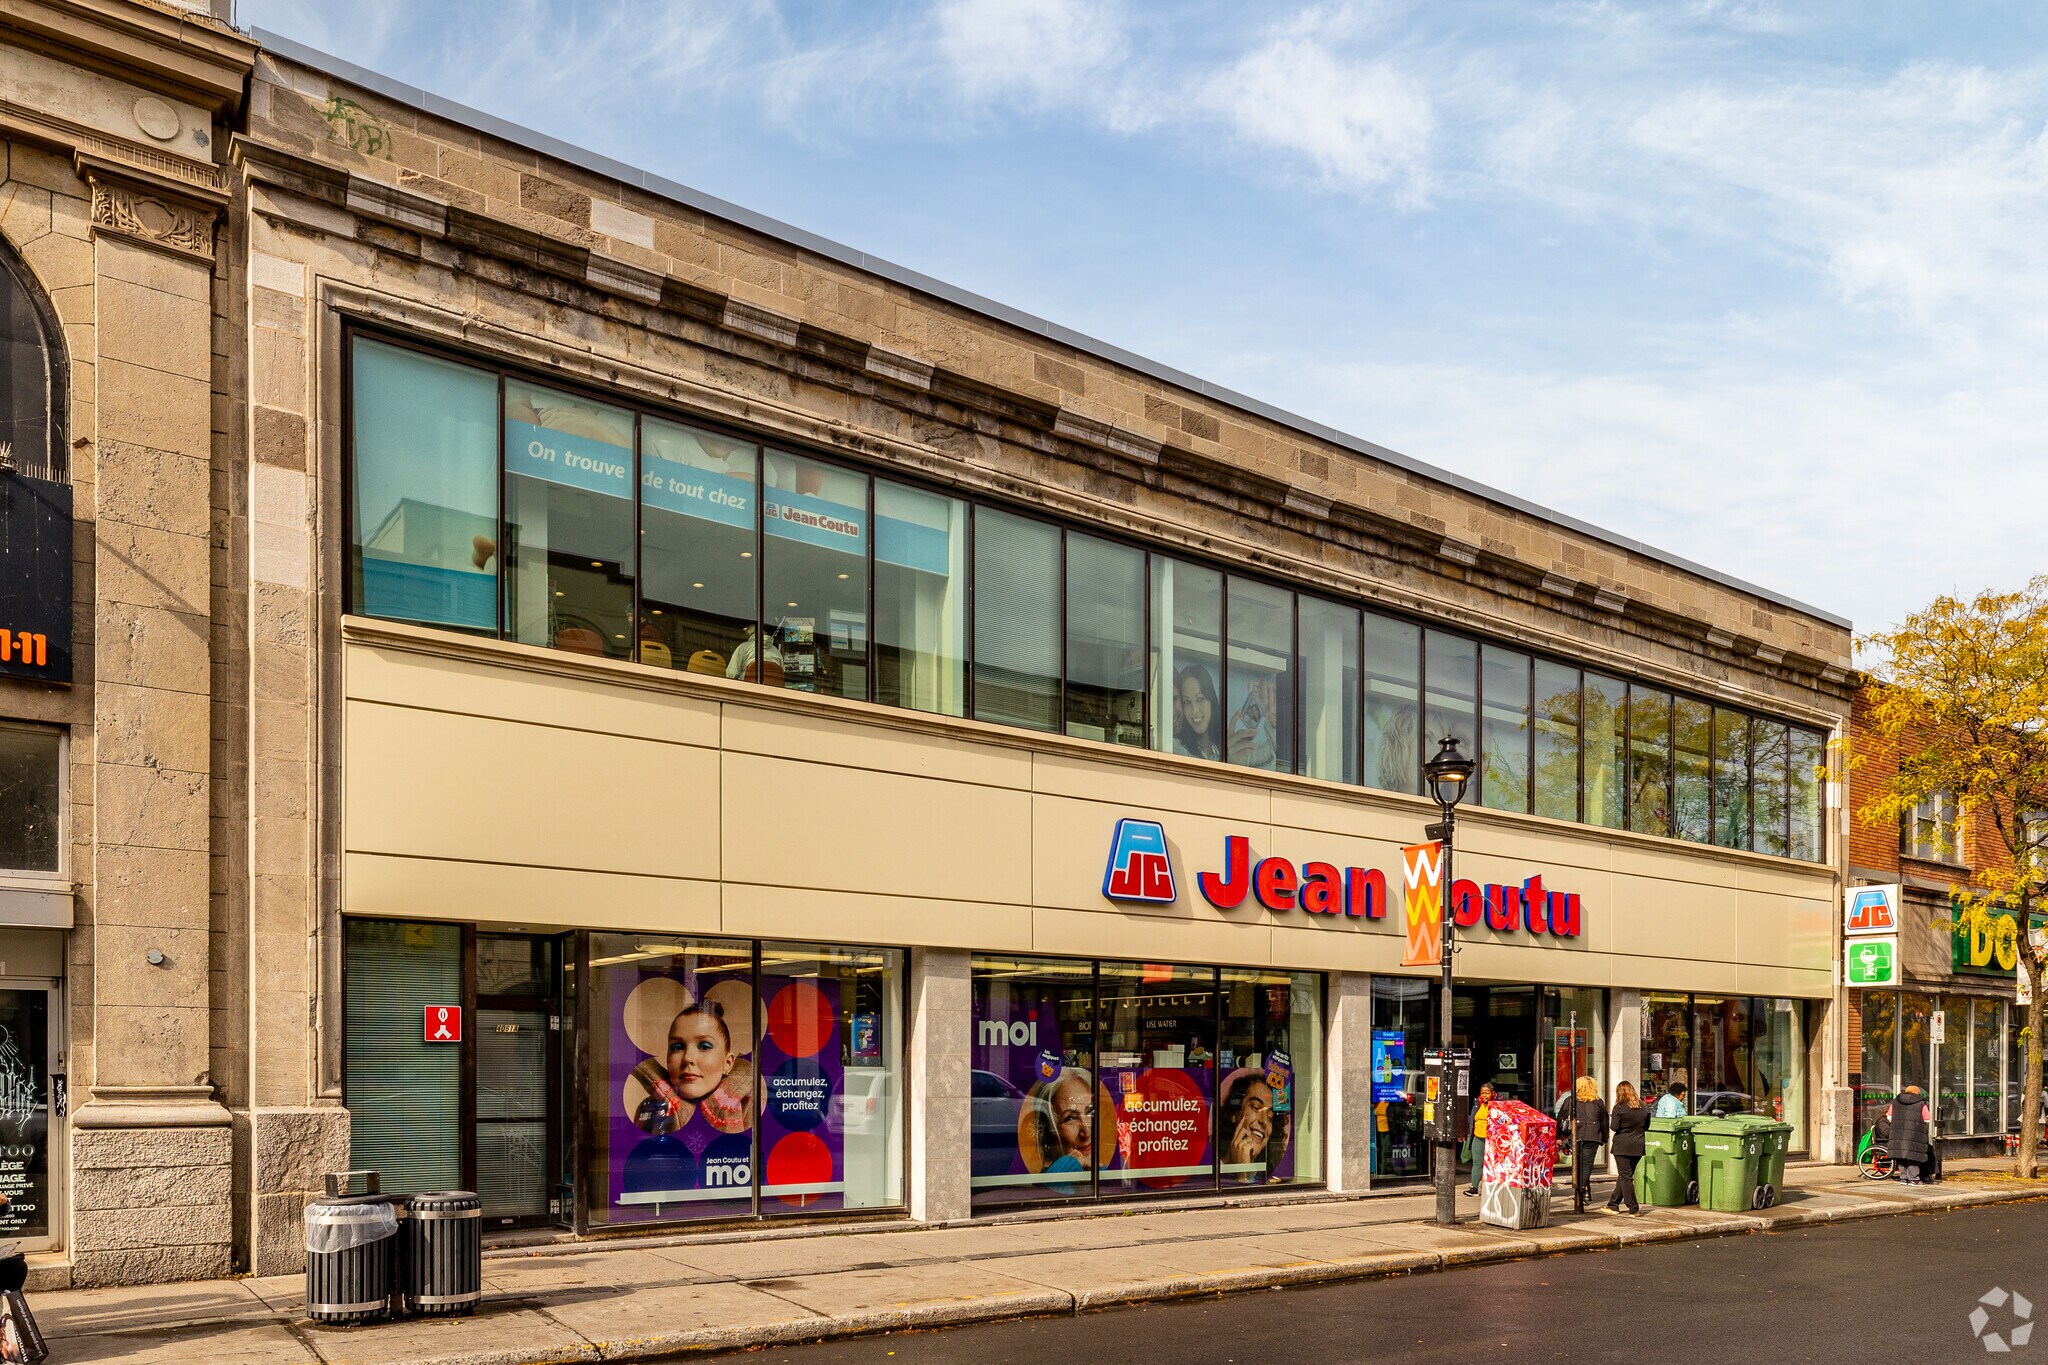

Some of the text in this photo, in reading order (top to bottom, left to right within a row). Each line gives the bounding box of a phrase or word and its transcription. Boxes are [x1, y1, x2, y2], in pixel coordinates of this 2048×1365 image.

[528, 440, 747, 510] On trouve de tout chez
[783, 507, 859, 536] Jean Coutu
[1197, 835, 1581, 937] Jean outu
[978, 1009, 1038, 1047] moi
[1157, 1019, 1178, 1029] WATIER
[773, 1077, 828, 1088] accumulez,
[775, 1089, 825, 1100] échangez,
[782, 1100, 819, 1112] profitez
[1124, 1097, 1201, 1113] accumulez,
[1129, 1117, 1197, 1135] échangez,
[1138, 1136, 1189, 1156] profitez
[706, 1164, 751, 1186] mo
